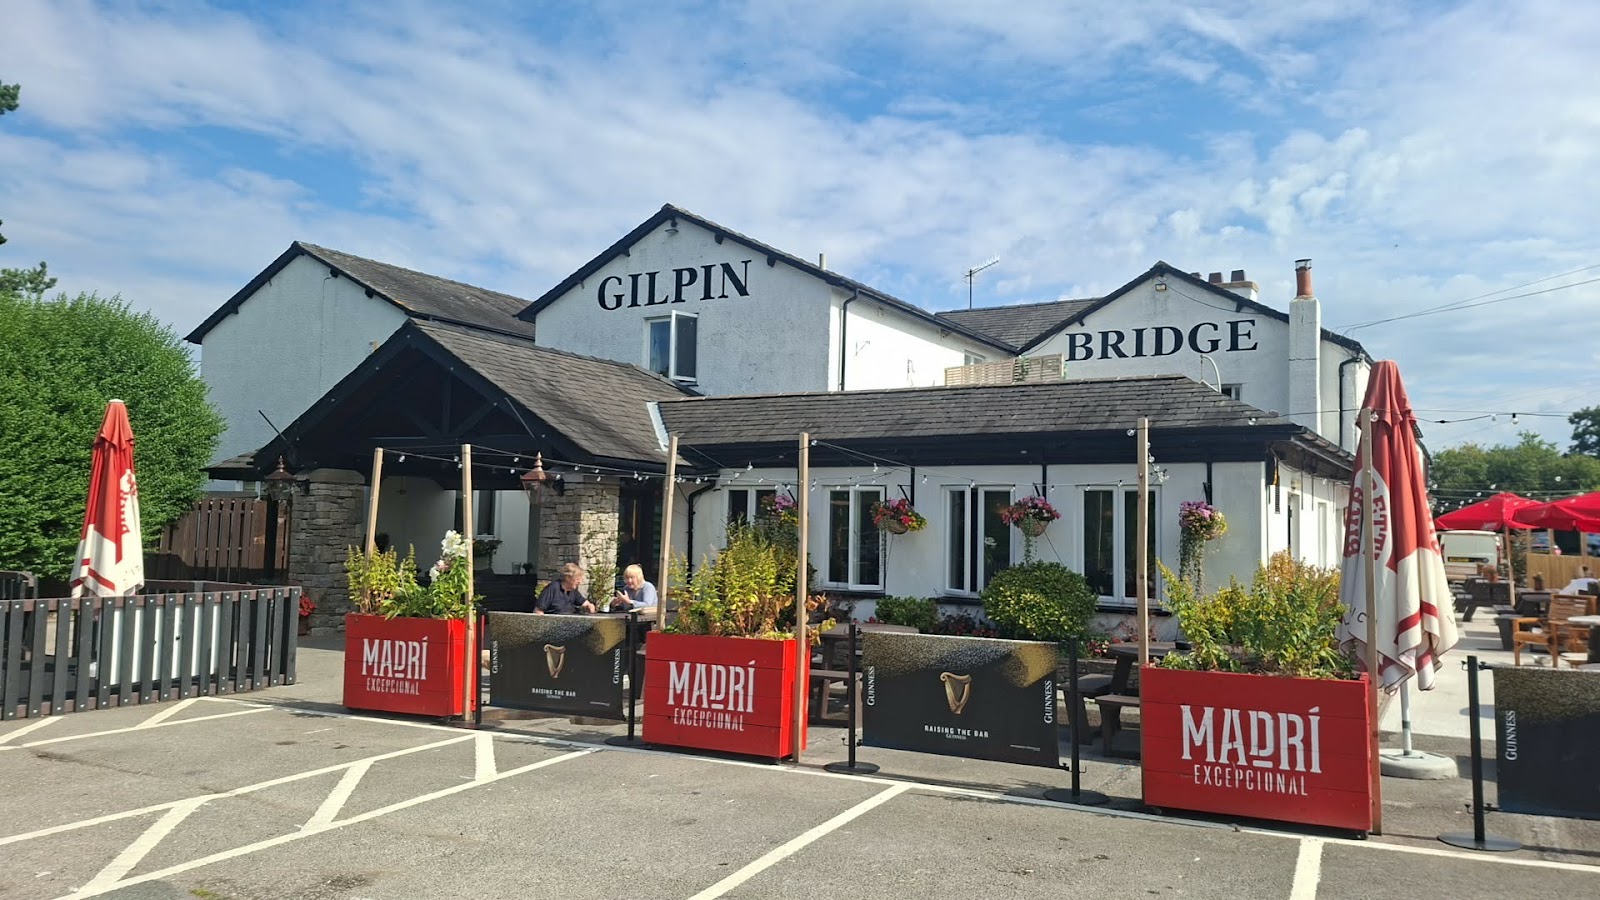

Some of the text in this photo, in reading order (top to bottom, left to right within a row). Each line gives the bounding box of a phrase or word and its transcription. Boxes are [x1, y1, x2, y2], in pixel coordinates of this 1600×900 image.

[597, 259, 752, 311] GILPIN
[1064, 319, 1259, 362] BRIDGE
[361, 635, 429, 680] MADRÍ
[491, 640, 499, 674] GUINNESS
[612, 648, 621, 685] GUINNESS
[366, 677, 421, 696] EXCEPCIONAL
[667, 659, 756, 713] MADRÍ
[866, 665, 876, 706] GUINNESS
[1043, 680, 1054, 724] GUINNESS
[673, 707, 745, 732] EXCEPCIONAL
[924, 724, 989, 738] RAISING THE BAR
[1180, 704, 1322, 774] MADRÍ
[1505, 710, 1518, 761] GUINNESS
[1193, 763, 1309, 796] EXCEPCIONAL
